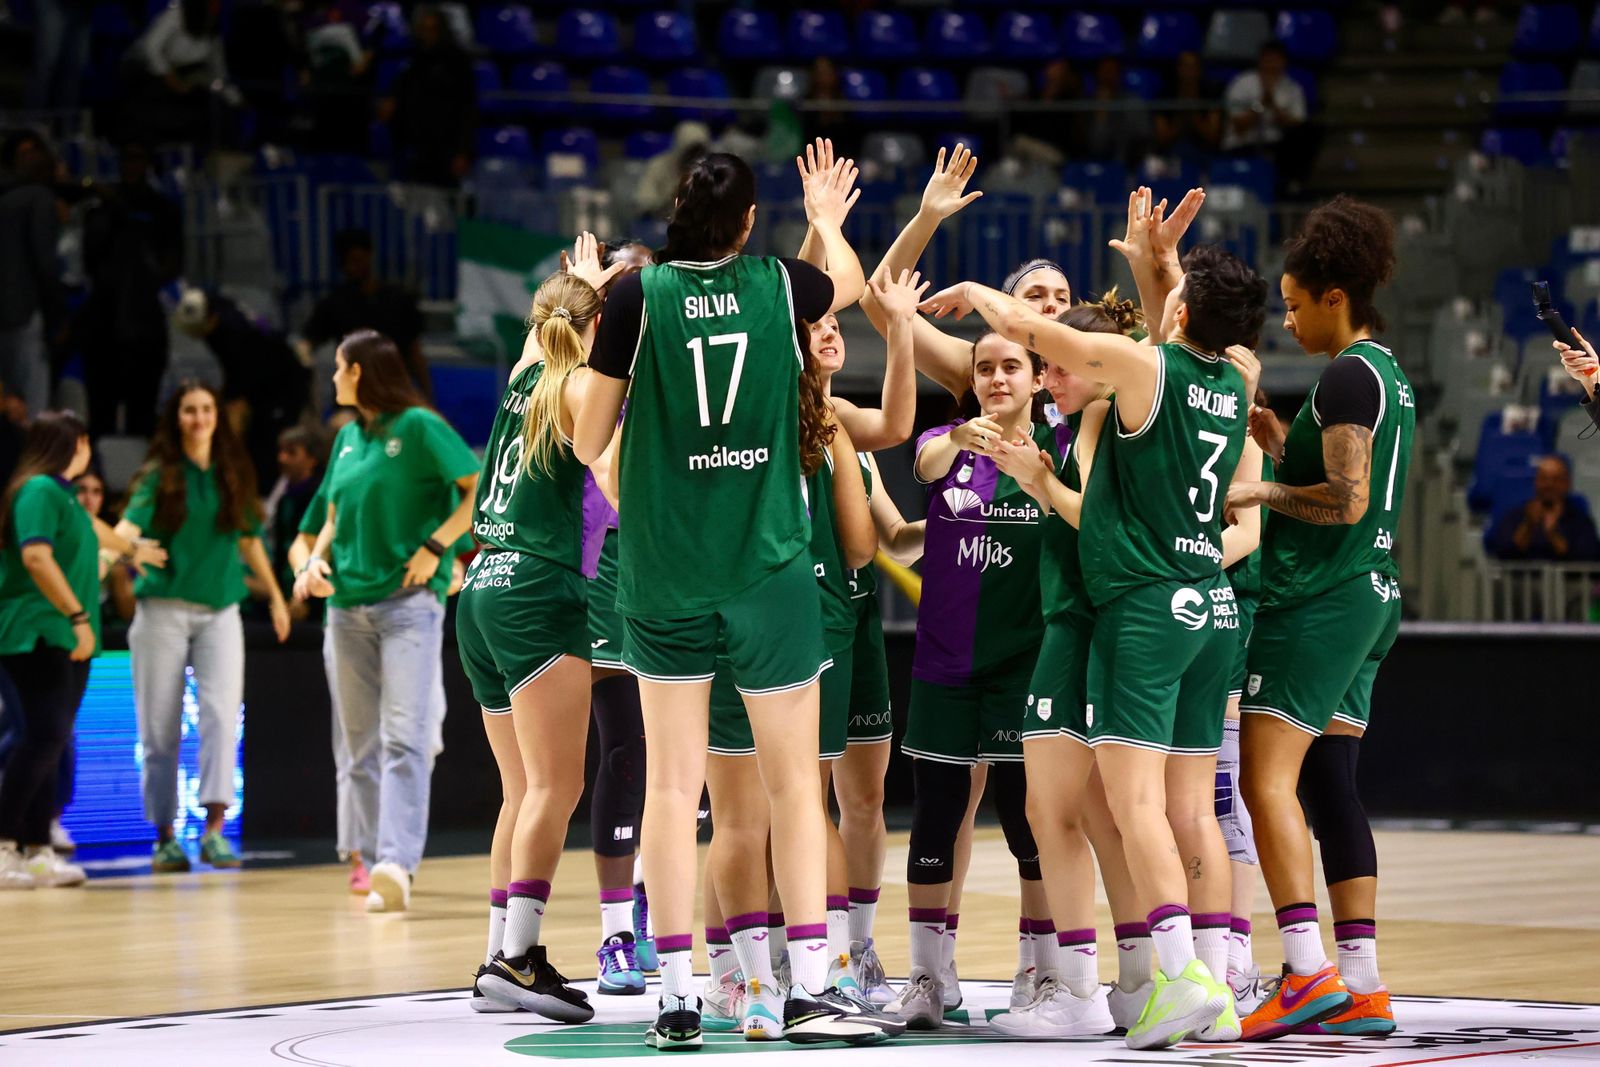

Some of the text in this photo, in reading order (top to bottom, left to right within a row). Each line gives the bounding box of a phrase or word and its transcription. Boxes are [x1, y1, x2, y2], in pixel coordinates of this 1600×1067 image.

[685, 293, 740, 319] SILVA
[686, 332, 748, 427] 17
[1188, 383, 1238, 419] SALOMÉ
[479, 434, 525, 514] 19
[688, 445, 769, 470] málaga
[1188, 429, 1228, 523] 3
[980, 501, 1039, 522] Unicaja
[957, 534, 1013, 573] Mijas
